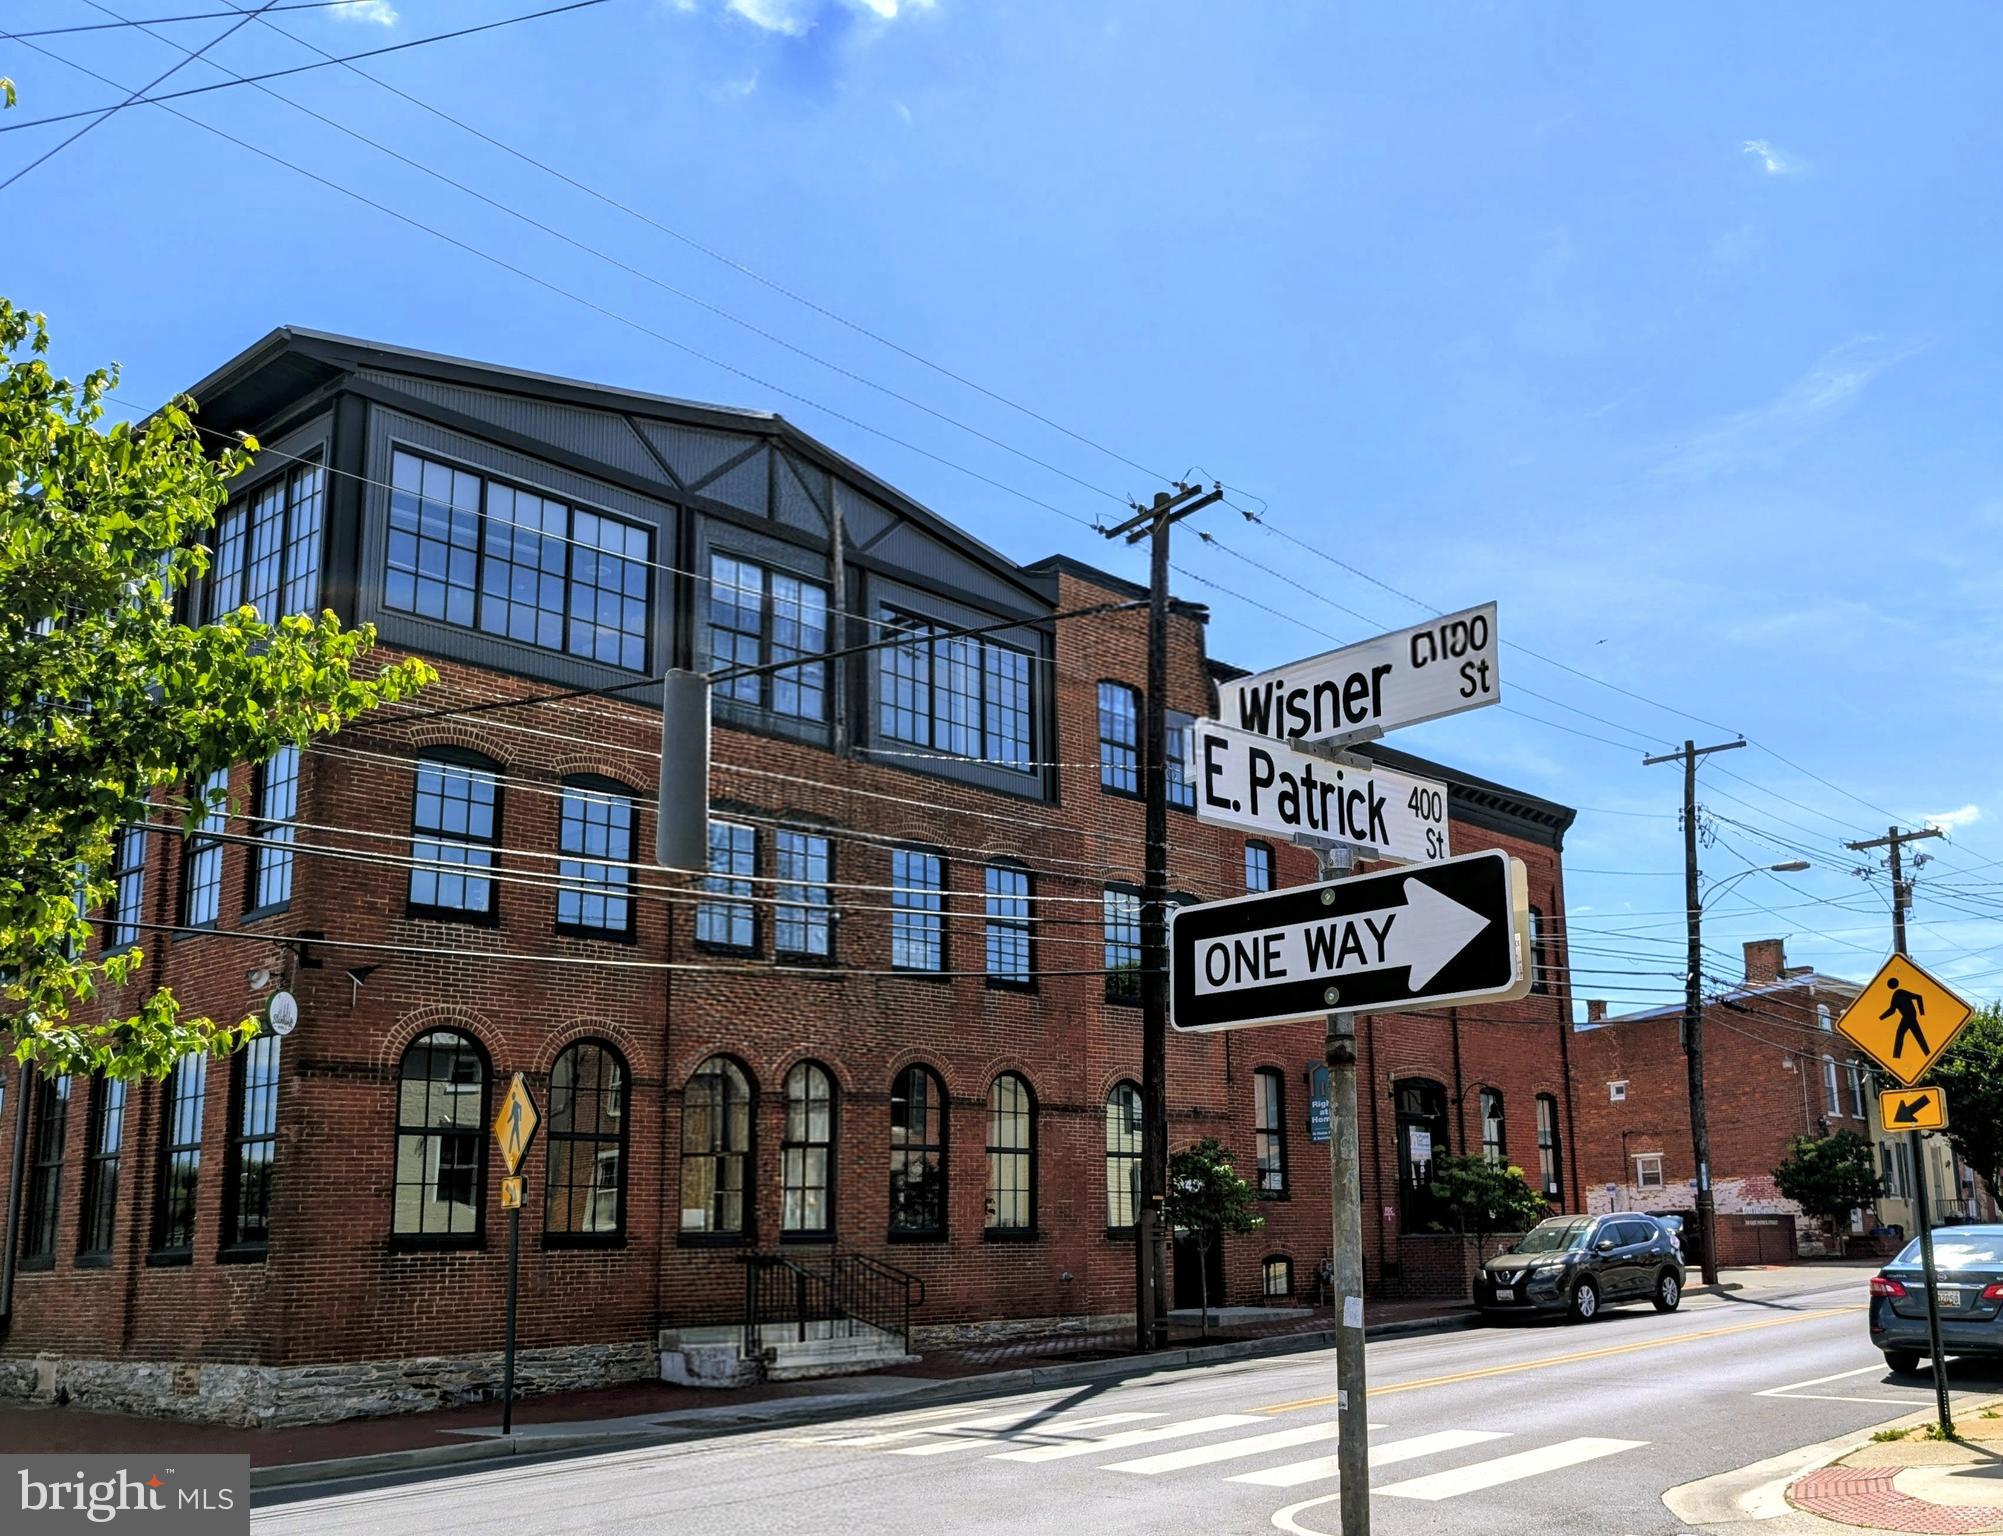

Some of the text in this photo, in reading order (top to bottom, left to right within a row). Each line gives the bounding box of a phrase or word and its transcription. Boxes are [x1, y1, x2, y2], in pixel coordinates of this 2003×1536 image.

[1239, 658, 1490, 740] Wisner St
[1407, 785, 1442, 824] 400
[1425, 830, 1443, 860] St
[1205, 913, 1397, 988] ONE WAY
